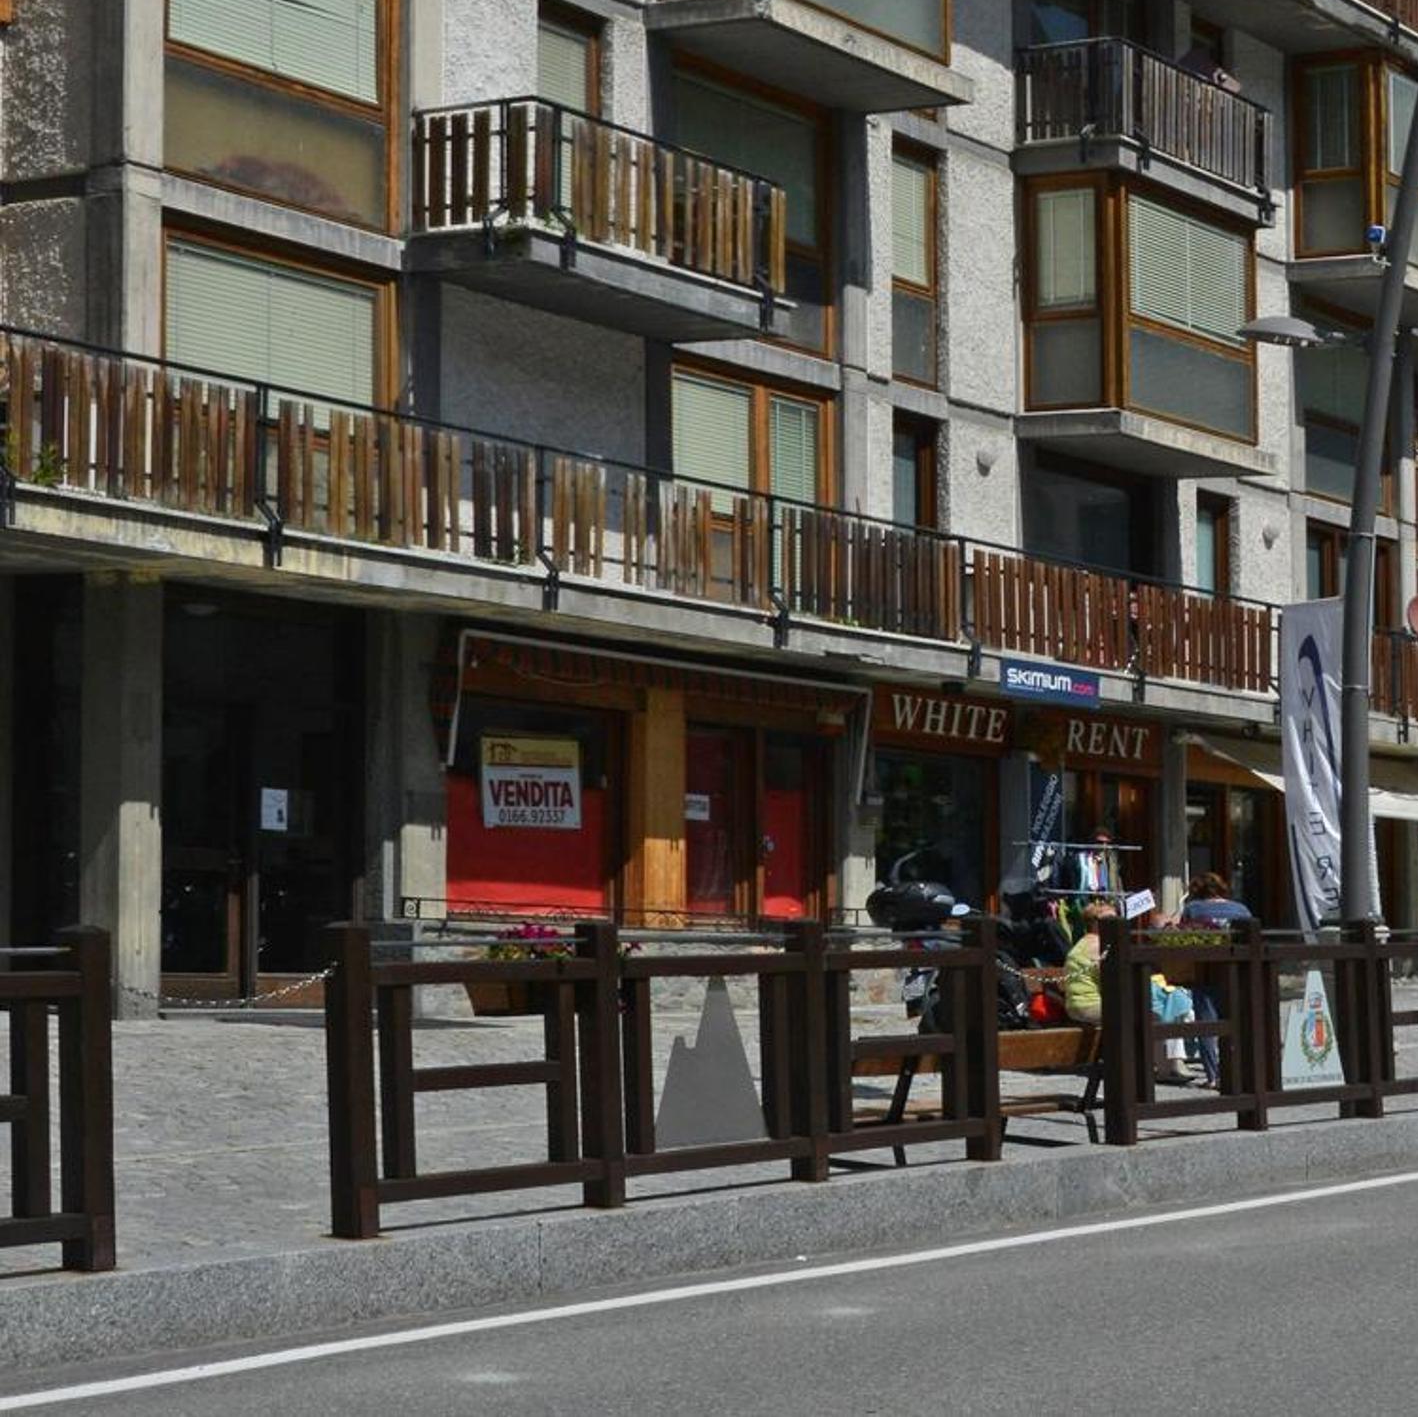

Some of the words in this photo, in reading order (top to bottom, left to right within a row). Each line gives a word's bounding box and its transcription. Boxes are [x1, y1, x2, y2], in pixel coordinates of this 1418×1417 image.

[891, 693, 1008, 743] WHITE
[1067, 719, 1149, 760] RENT
[488, 779, 574, 808] VENDITA
